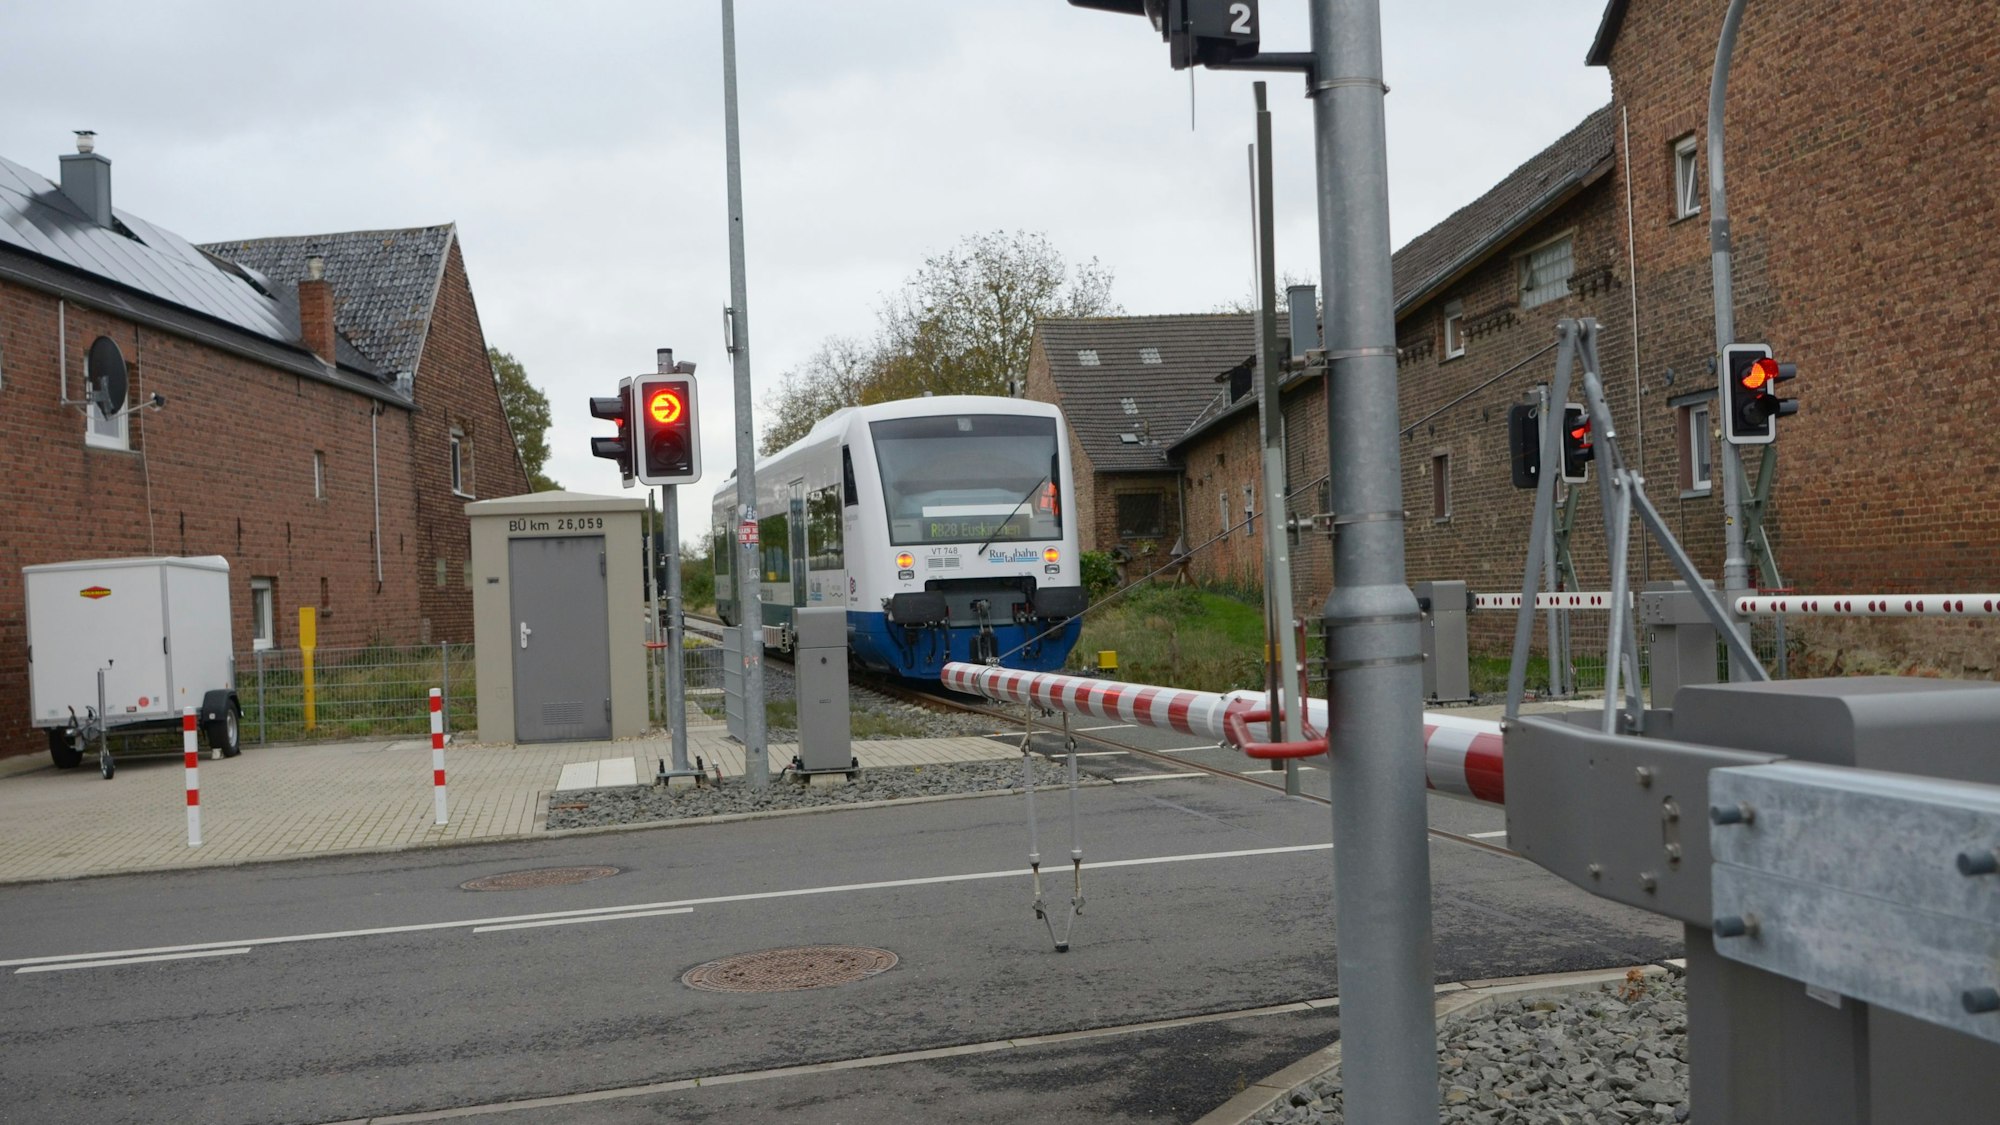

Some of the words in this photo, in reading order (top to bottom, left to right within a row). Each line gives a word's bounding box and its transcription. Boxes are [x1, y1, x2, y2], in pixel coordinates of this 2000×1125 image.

[1229, 3, 1251, 34] 2
[509, 518, 526, 531] BÜ
[530, 520, 549, 531] km
[558, 517, 603, 531] 26,059
[931, 547, 942, 555] VT
[944, 546, 958, 555] 748
